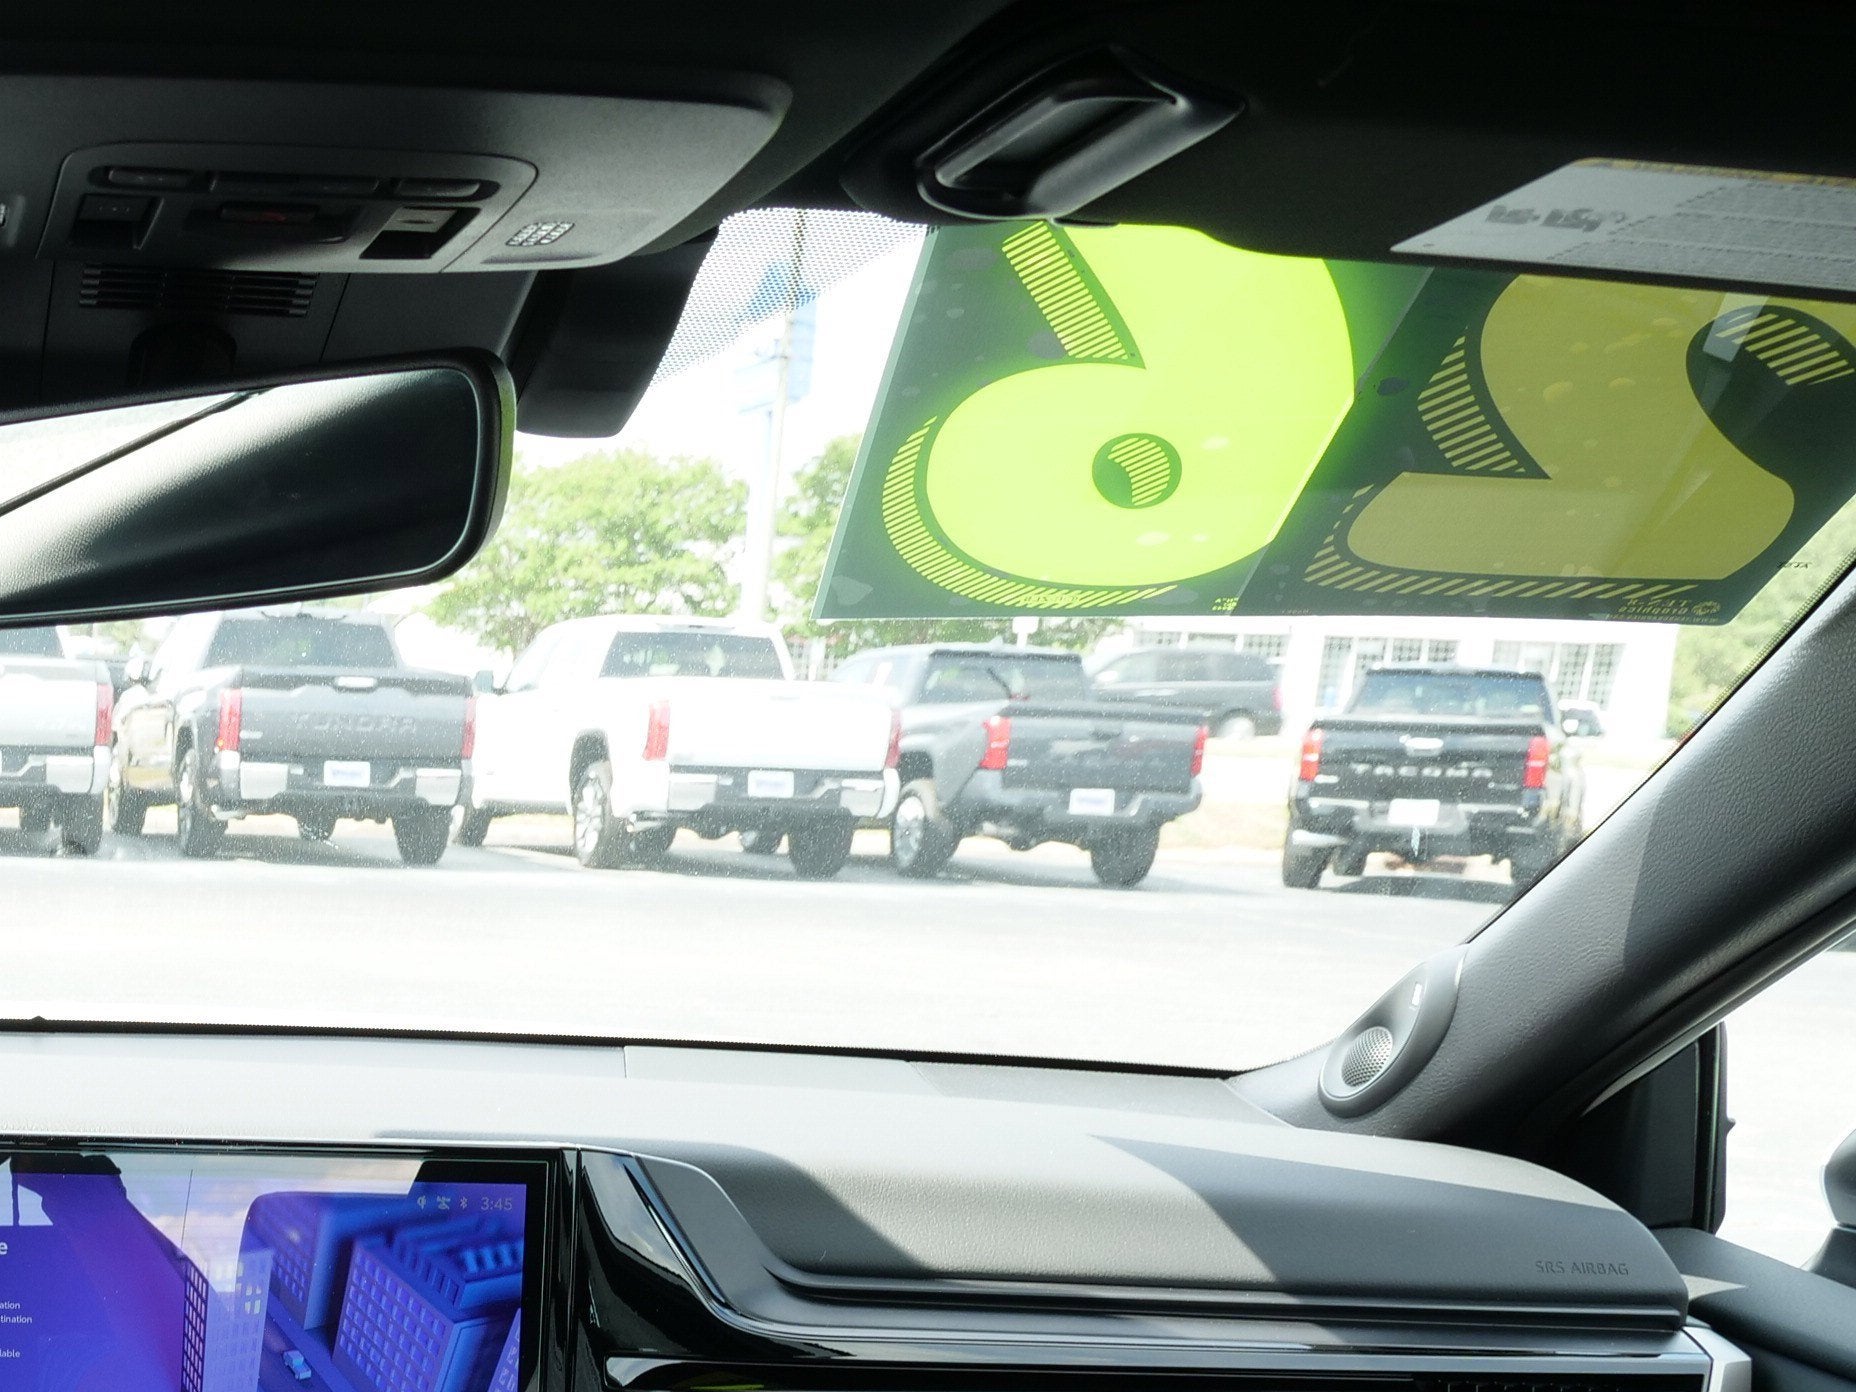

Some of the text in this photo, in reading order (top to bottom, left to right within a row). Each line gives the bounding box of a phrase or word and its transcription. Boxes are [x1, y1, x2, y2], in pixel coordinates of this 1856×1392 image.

[1349, 762, 1493, 779] TACOMA
[480, 1196, 513, 1212] 3:45
[1535, 1260, 1630, 1277] SRS AIRBAG
